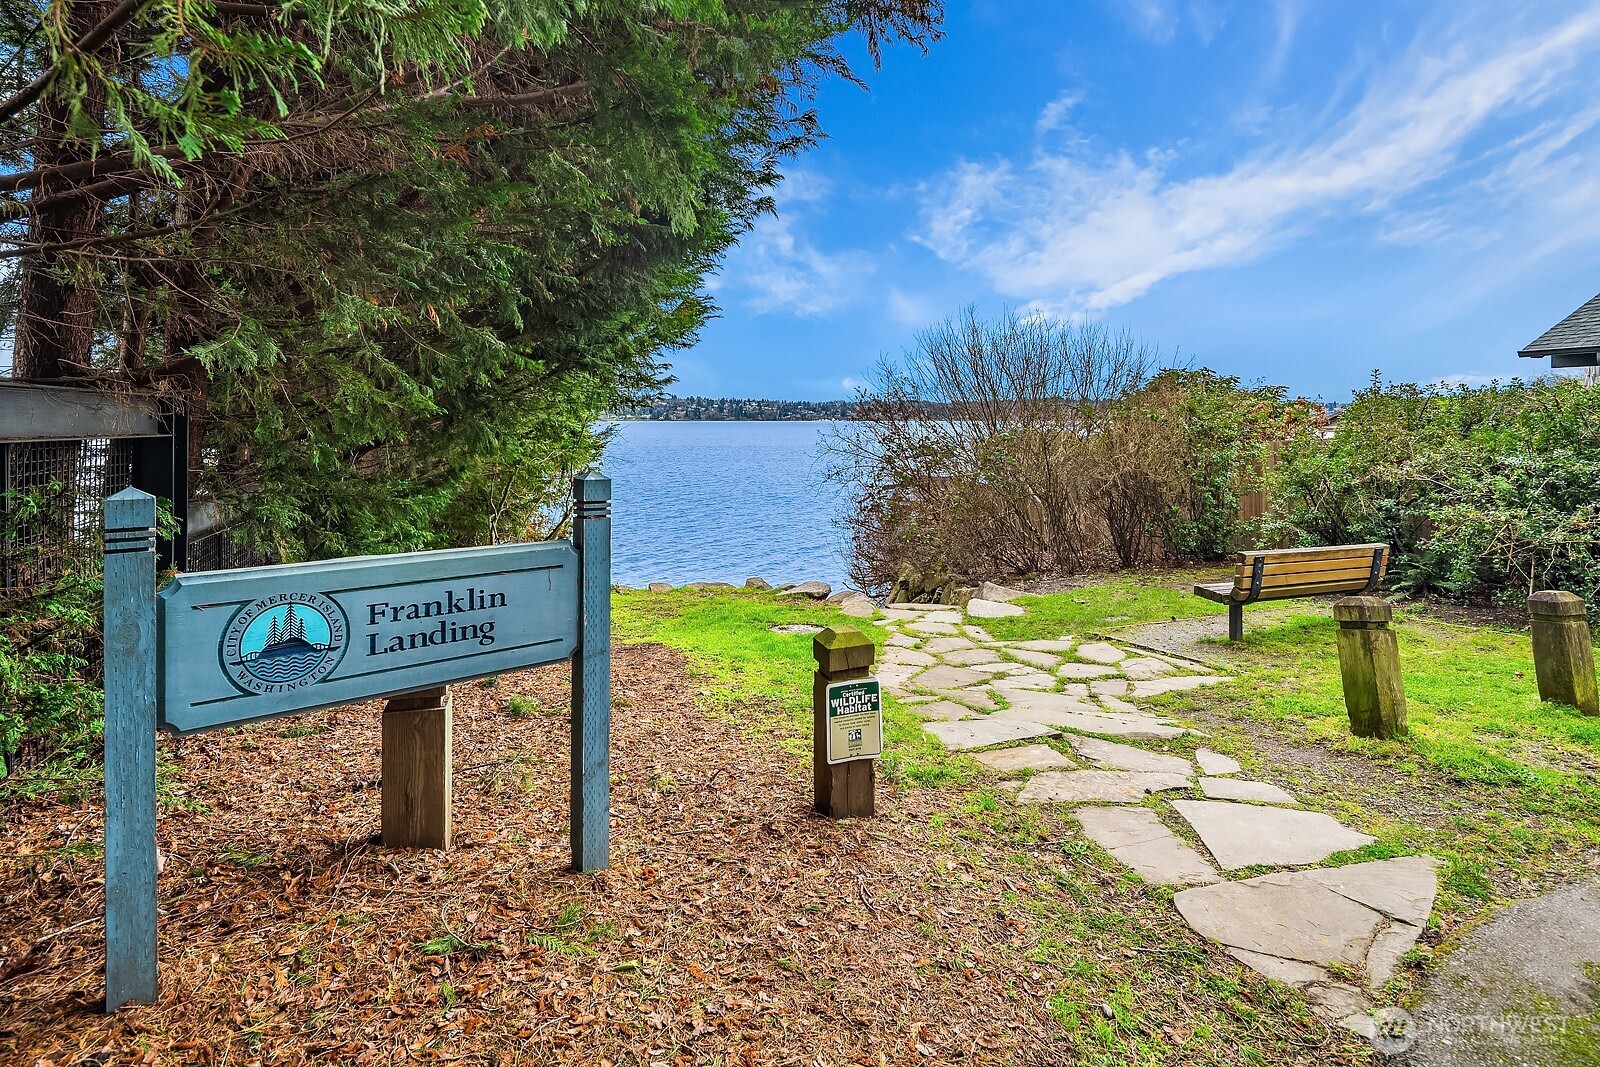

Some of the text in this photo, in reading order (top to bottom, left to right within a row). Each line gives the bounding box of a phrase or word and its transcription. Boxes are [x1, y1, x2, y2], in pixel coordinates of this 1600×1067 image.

[226, 592, 343, 657] CITY OF MERCER ISLAND
[366, 587, 507, 626] Franklin
[365, 620, 496, 657] Landing
[236, 656, 335, 693] WASHINGTON
[831, 693, 878, 708] WILDLIFE
[836, 702, 872, 715] Habitat
[842, 690, 865, 698] Certified
